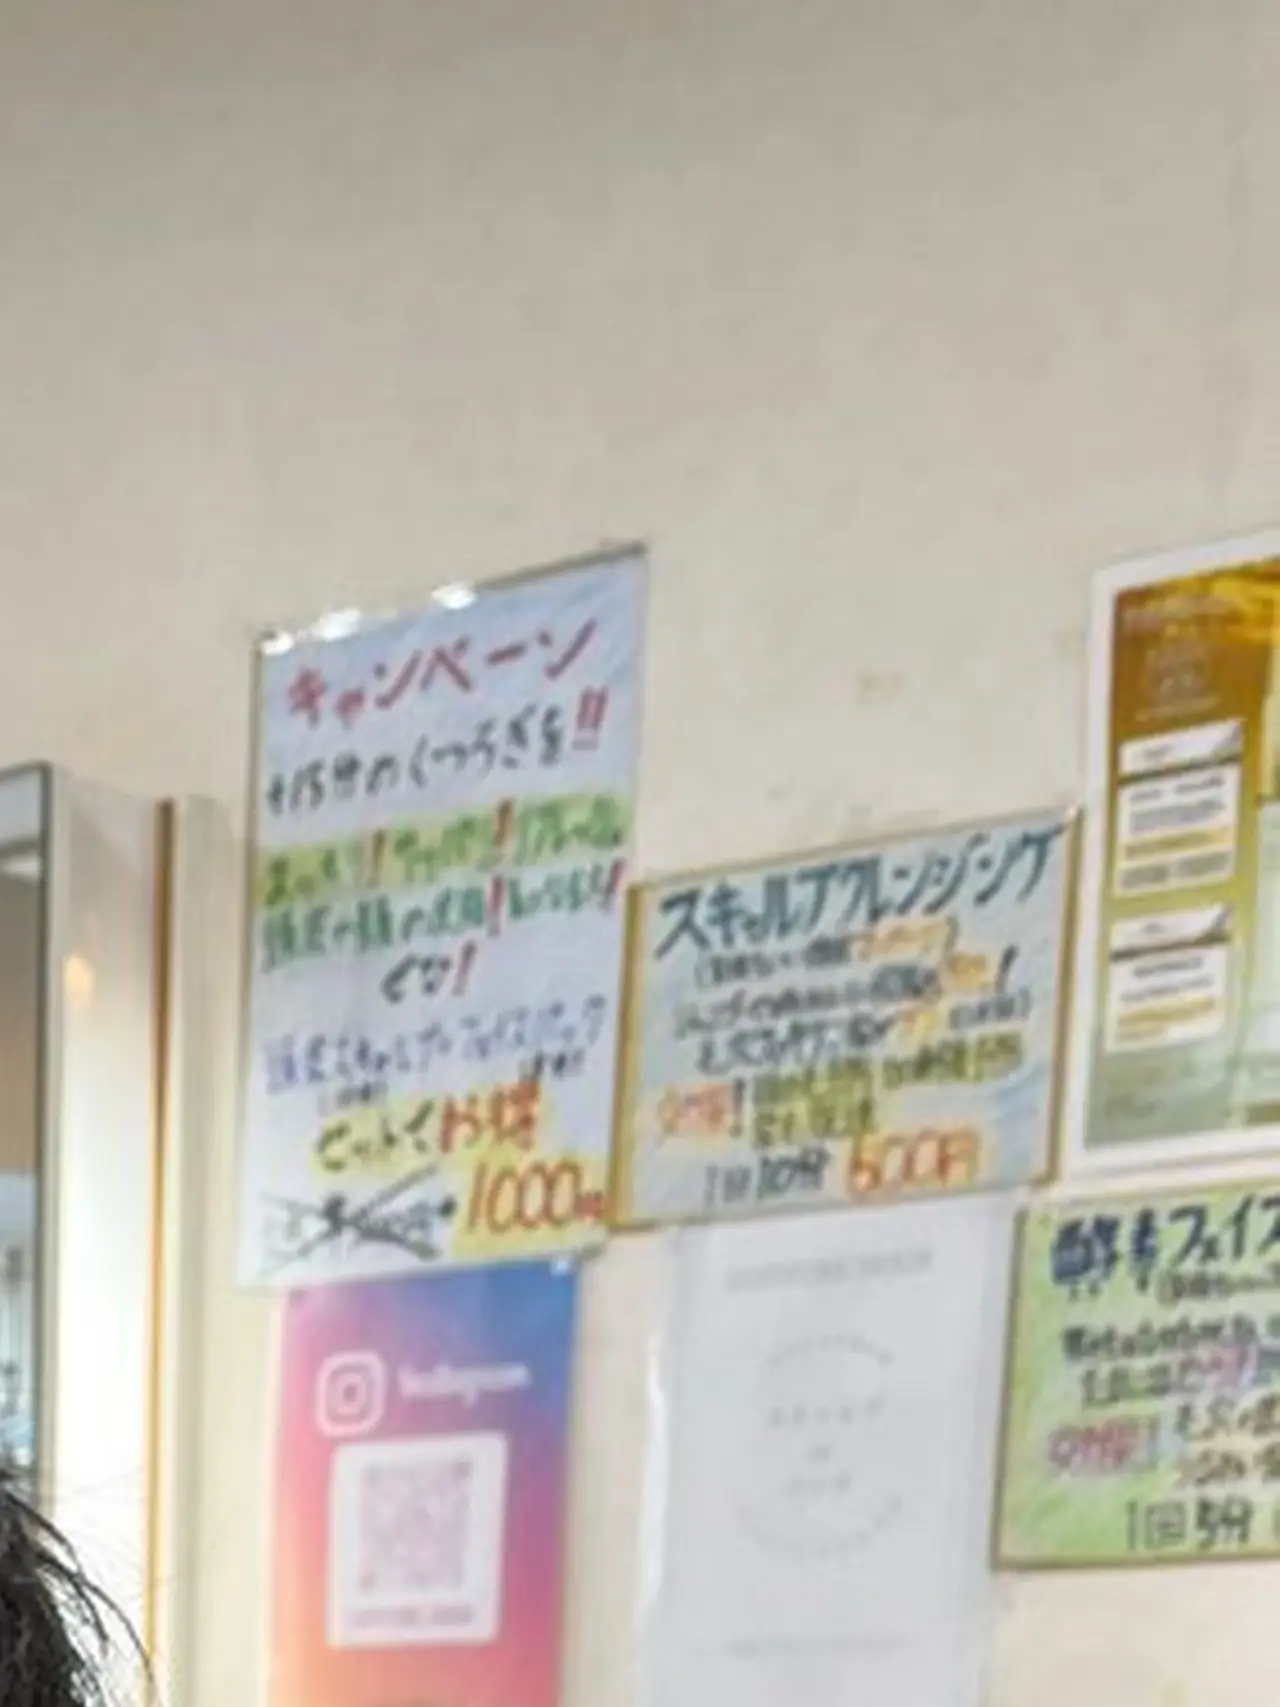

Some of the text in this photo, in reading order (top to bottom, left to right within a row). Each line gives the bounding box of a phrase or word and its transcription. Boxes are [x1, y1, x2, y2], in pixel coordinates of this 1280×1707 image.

[286, 617, 597, 730] キャンペーン
